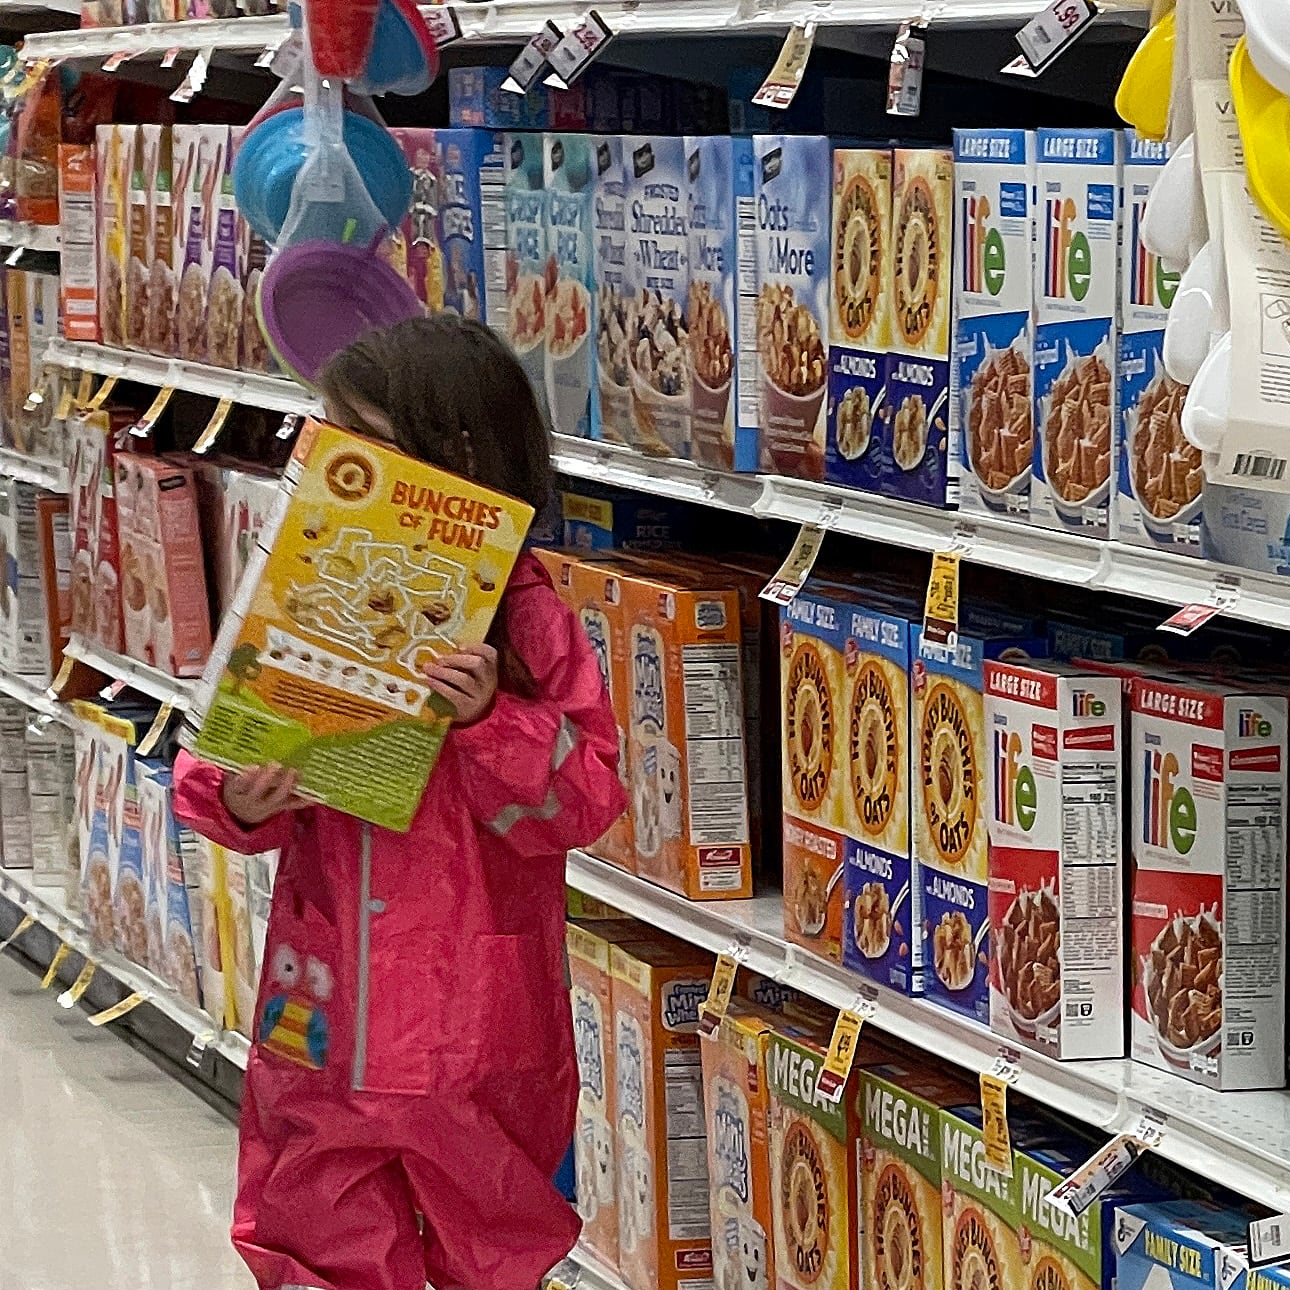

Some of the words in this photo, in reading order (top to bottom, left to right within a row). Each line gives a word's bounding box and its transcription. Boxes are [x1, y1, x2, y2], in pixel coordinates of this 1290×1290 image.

[391, 480, 502, 529] BUNCHES
[428, 518, 484, 553] FUN!
[990, 675, 1019, 696] LARGE
[1021, 681, 1043, 700] SIZE
[1072, 690, 1106, 718] life
[856, 848, 892, 880] ALMONDS
[933, 876, 975, 909] ALMONDS
[865, 1083, 923, 1155] MEGA
